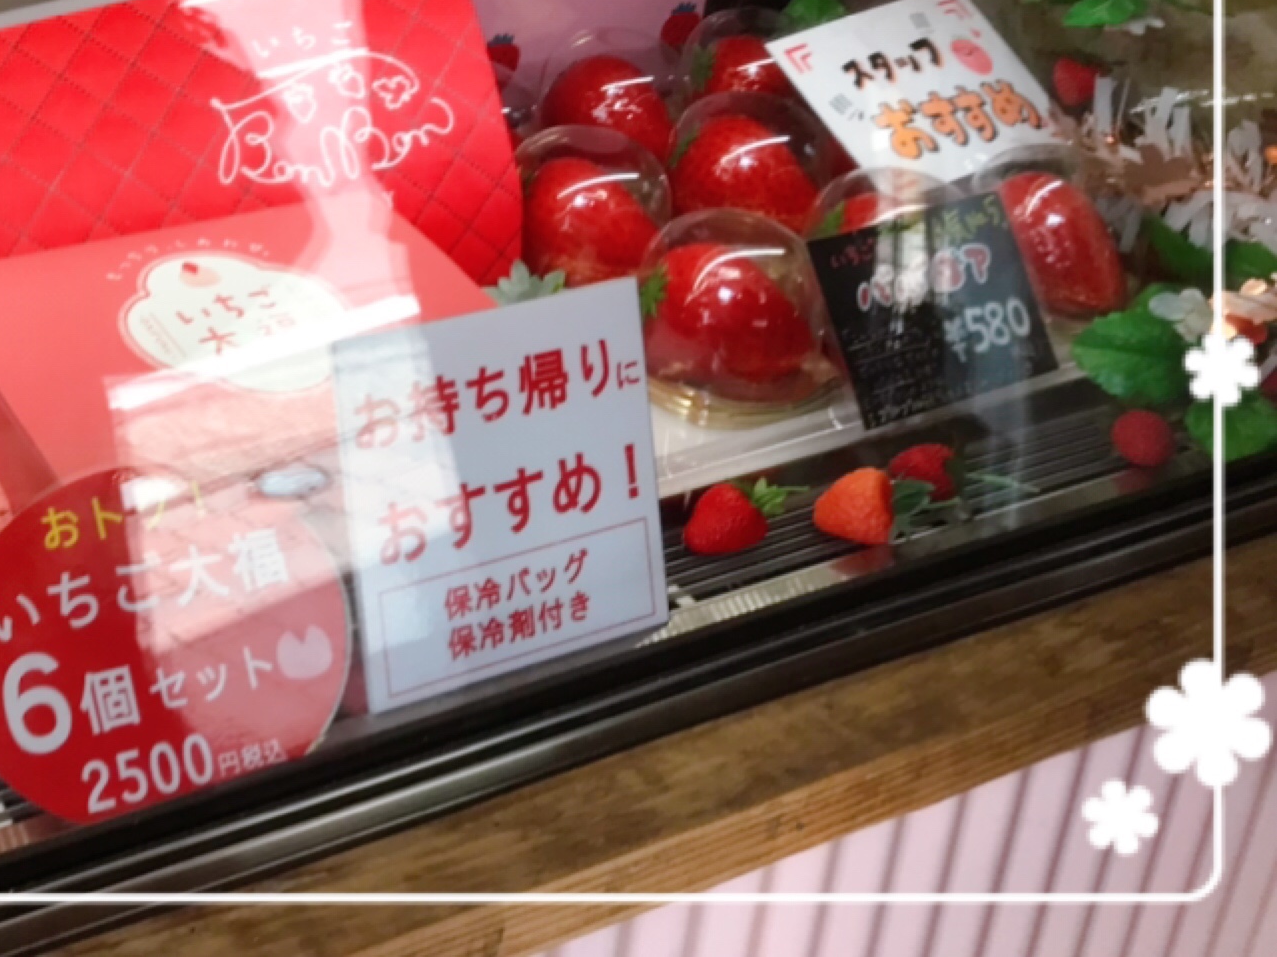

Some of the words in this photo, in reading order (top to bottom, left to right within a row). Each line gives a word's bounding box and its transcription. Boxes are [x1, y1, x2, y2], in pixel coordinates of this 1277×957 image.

[872, 79, 1042, 159] おすすめ
[354, 339, 641, 450] お持ち帰りに
[444, 549, 588, 619] 保冷バッグ
[448, 591, 591, 661] 保冷剤付き
